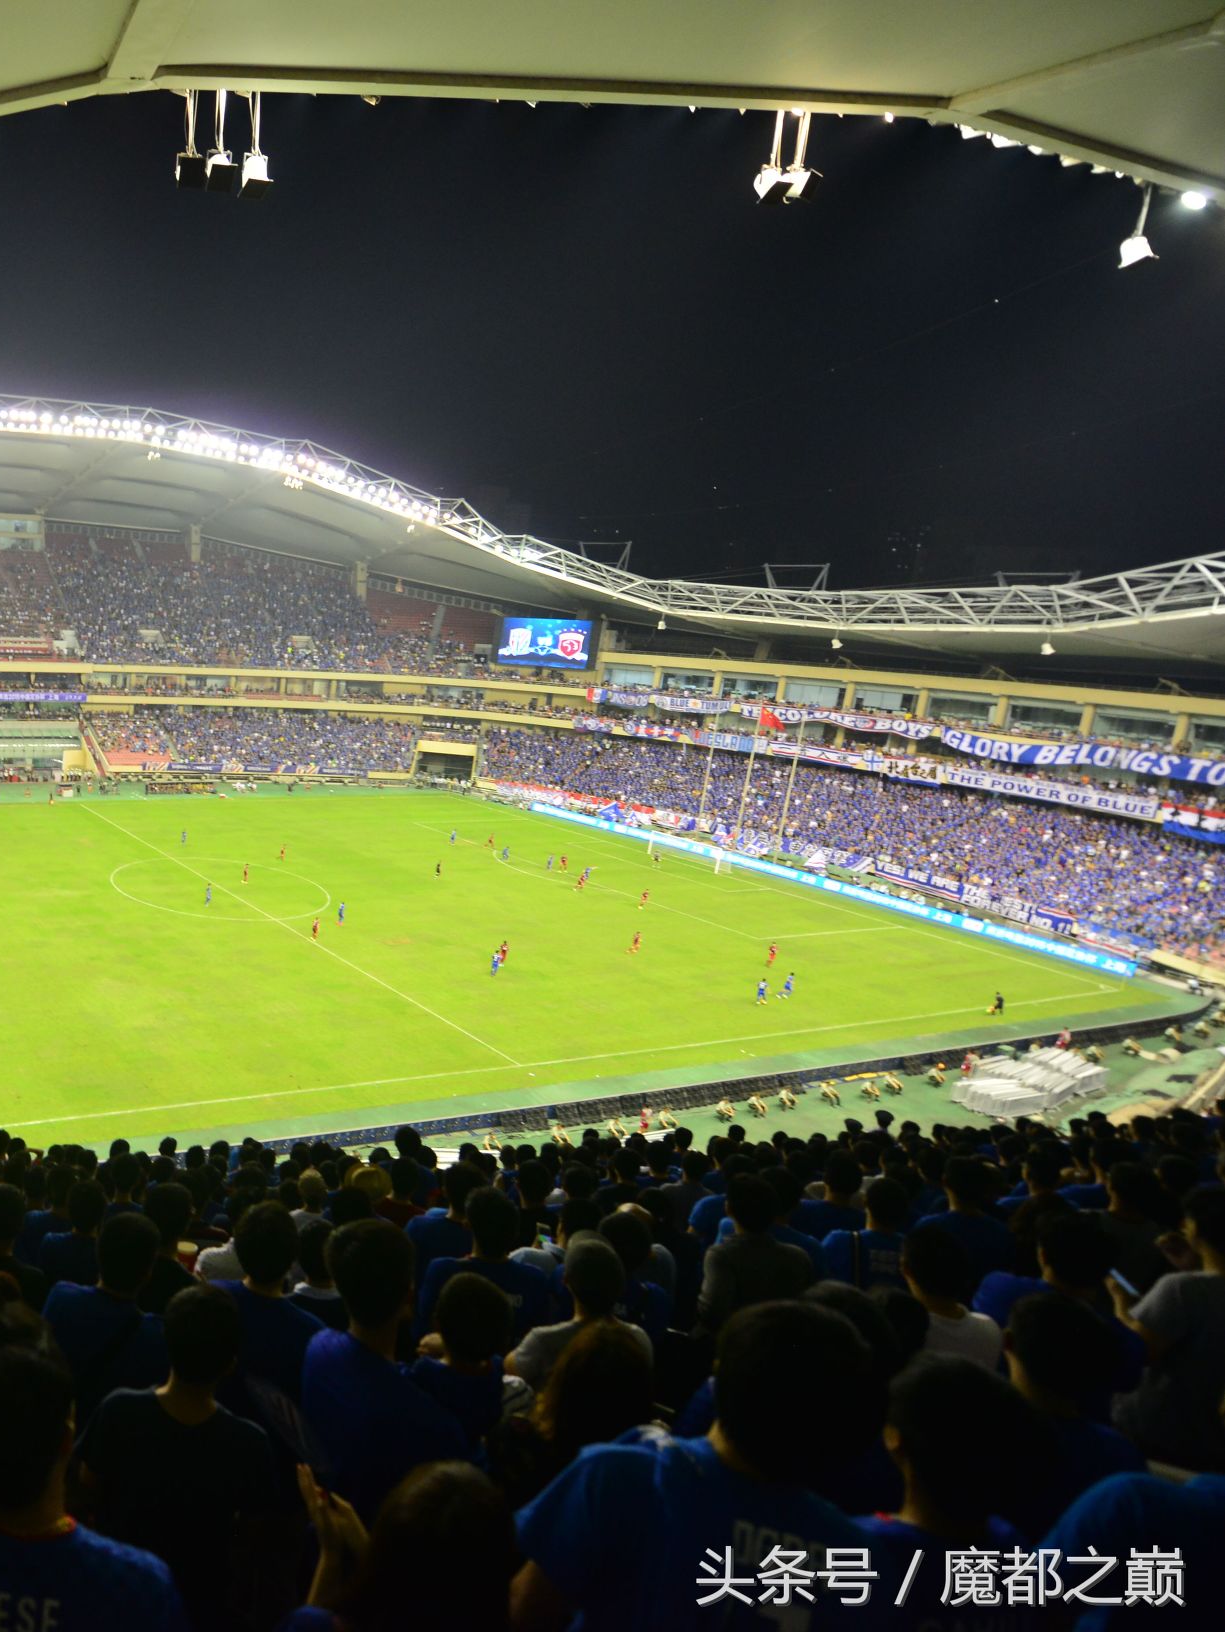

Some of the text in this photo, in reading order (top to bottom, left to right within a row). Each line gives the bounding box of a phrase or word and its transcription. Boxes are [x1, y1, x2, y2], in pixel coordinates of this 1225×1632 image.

[875, 717, 933, 738] BOYS
[946, 729, 1225, 786] GLORY BELONGS TO
[948, 772, 1153, 815] THE POWER OF BLUE
[876, 860, 960, 892] YES! WE ARE
[963, 884, 989, 899] THE
[961, 894, 1028, 922] FOREVER
